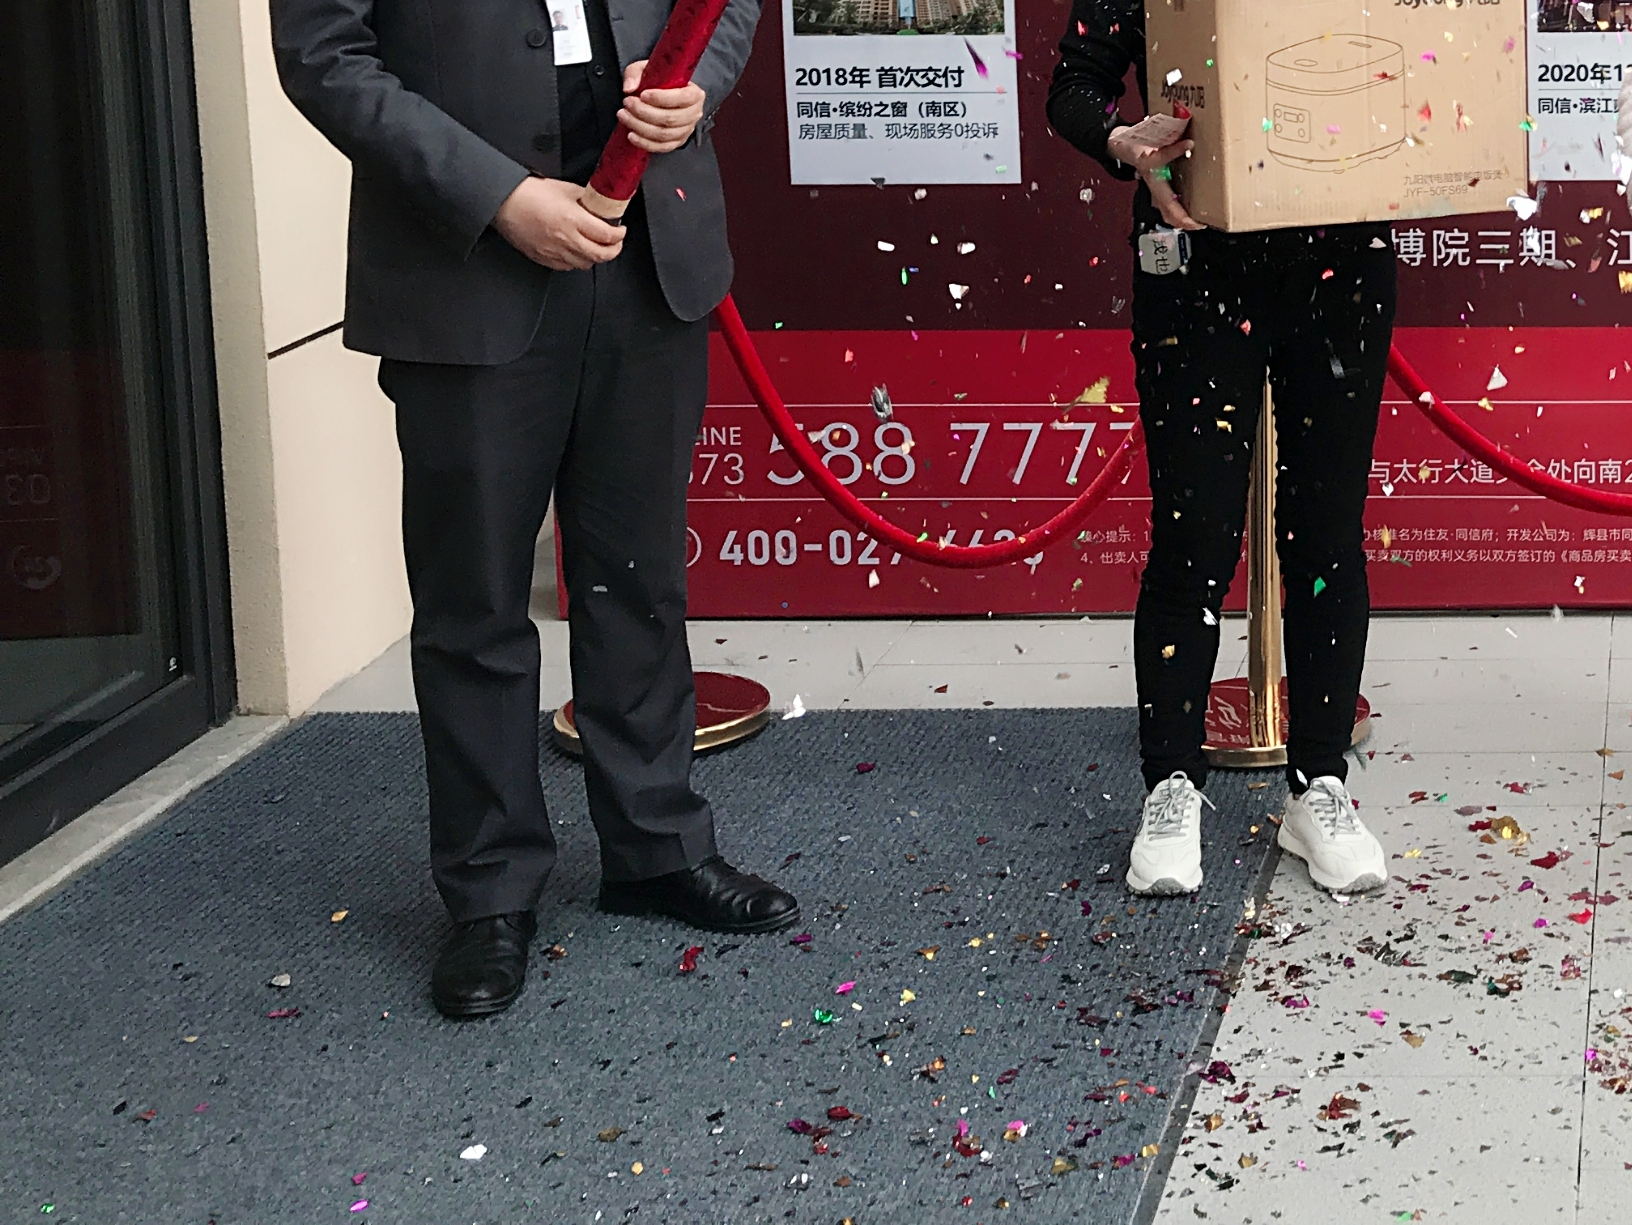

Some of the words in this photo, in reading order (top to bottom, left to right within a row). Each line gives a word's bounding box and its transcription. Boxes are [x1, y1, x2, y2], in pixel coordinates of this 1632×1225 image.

[794, 66, 872, 88] 2018年
[875, 65, 965, 88] 首次交付
[1403, 184, 1469, 198] JYF-50FS69
[695, 426, 742, 446] INE
[688, 453, 745, 485] 73
